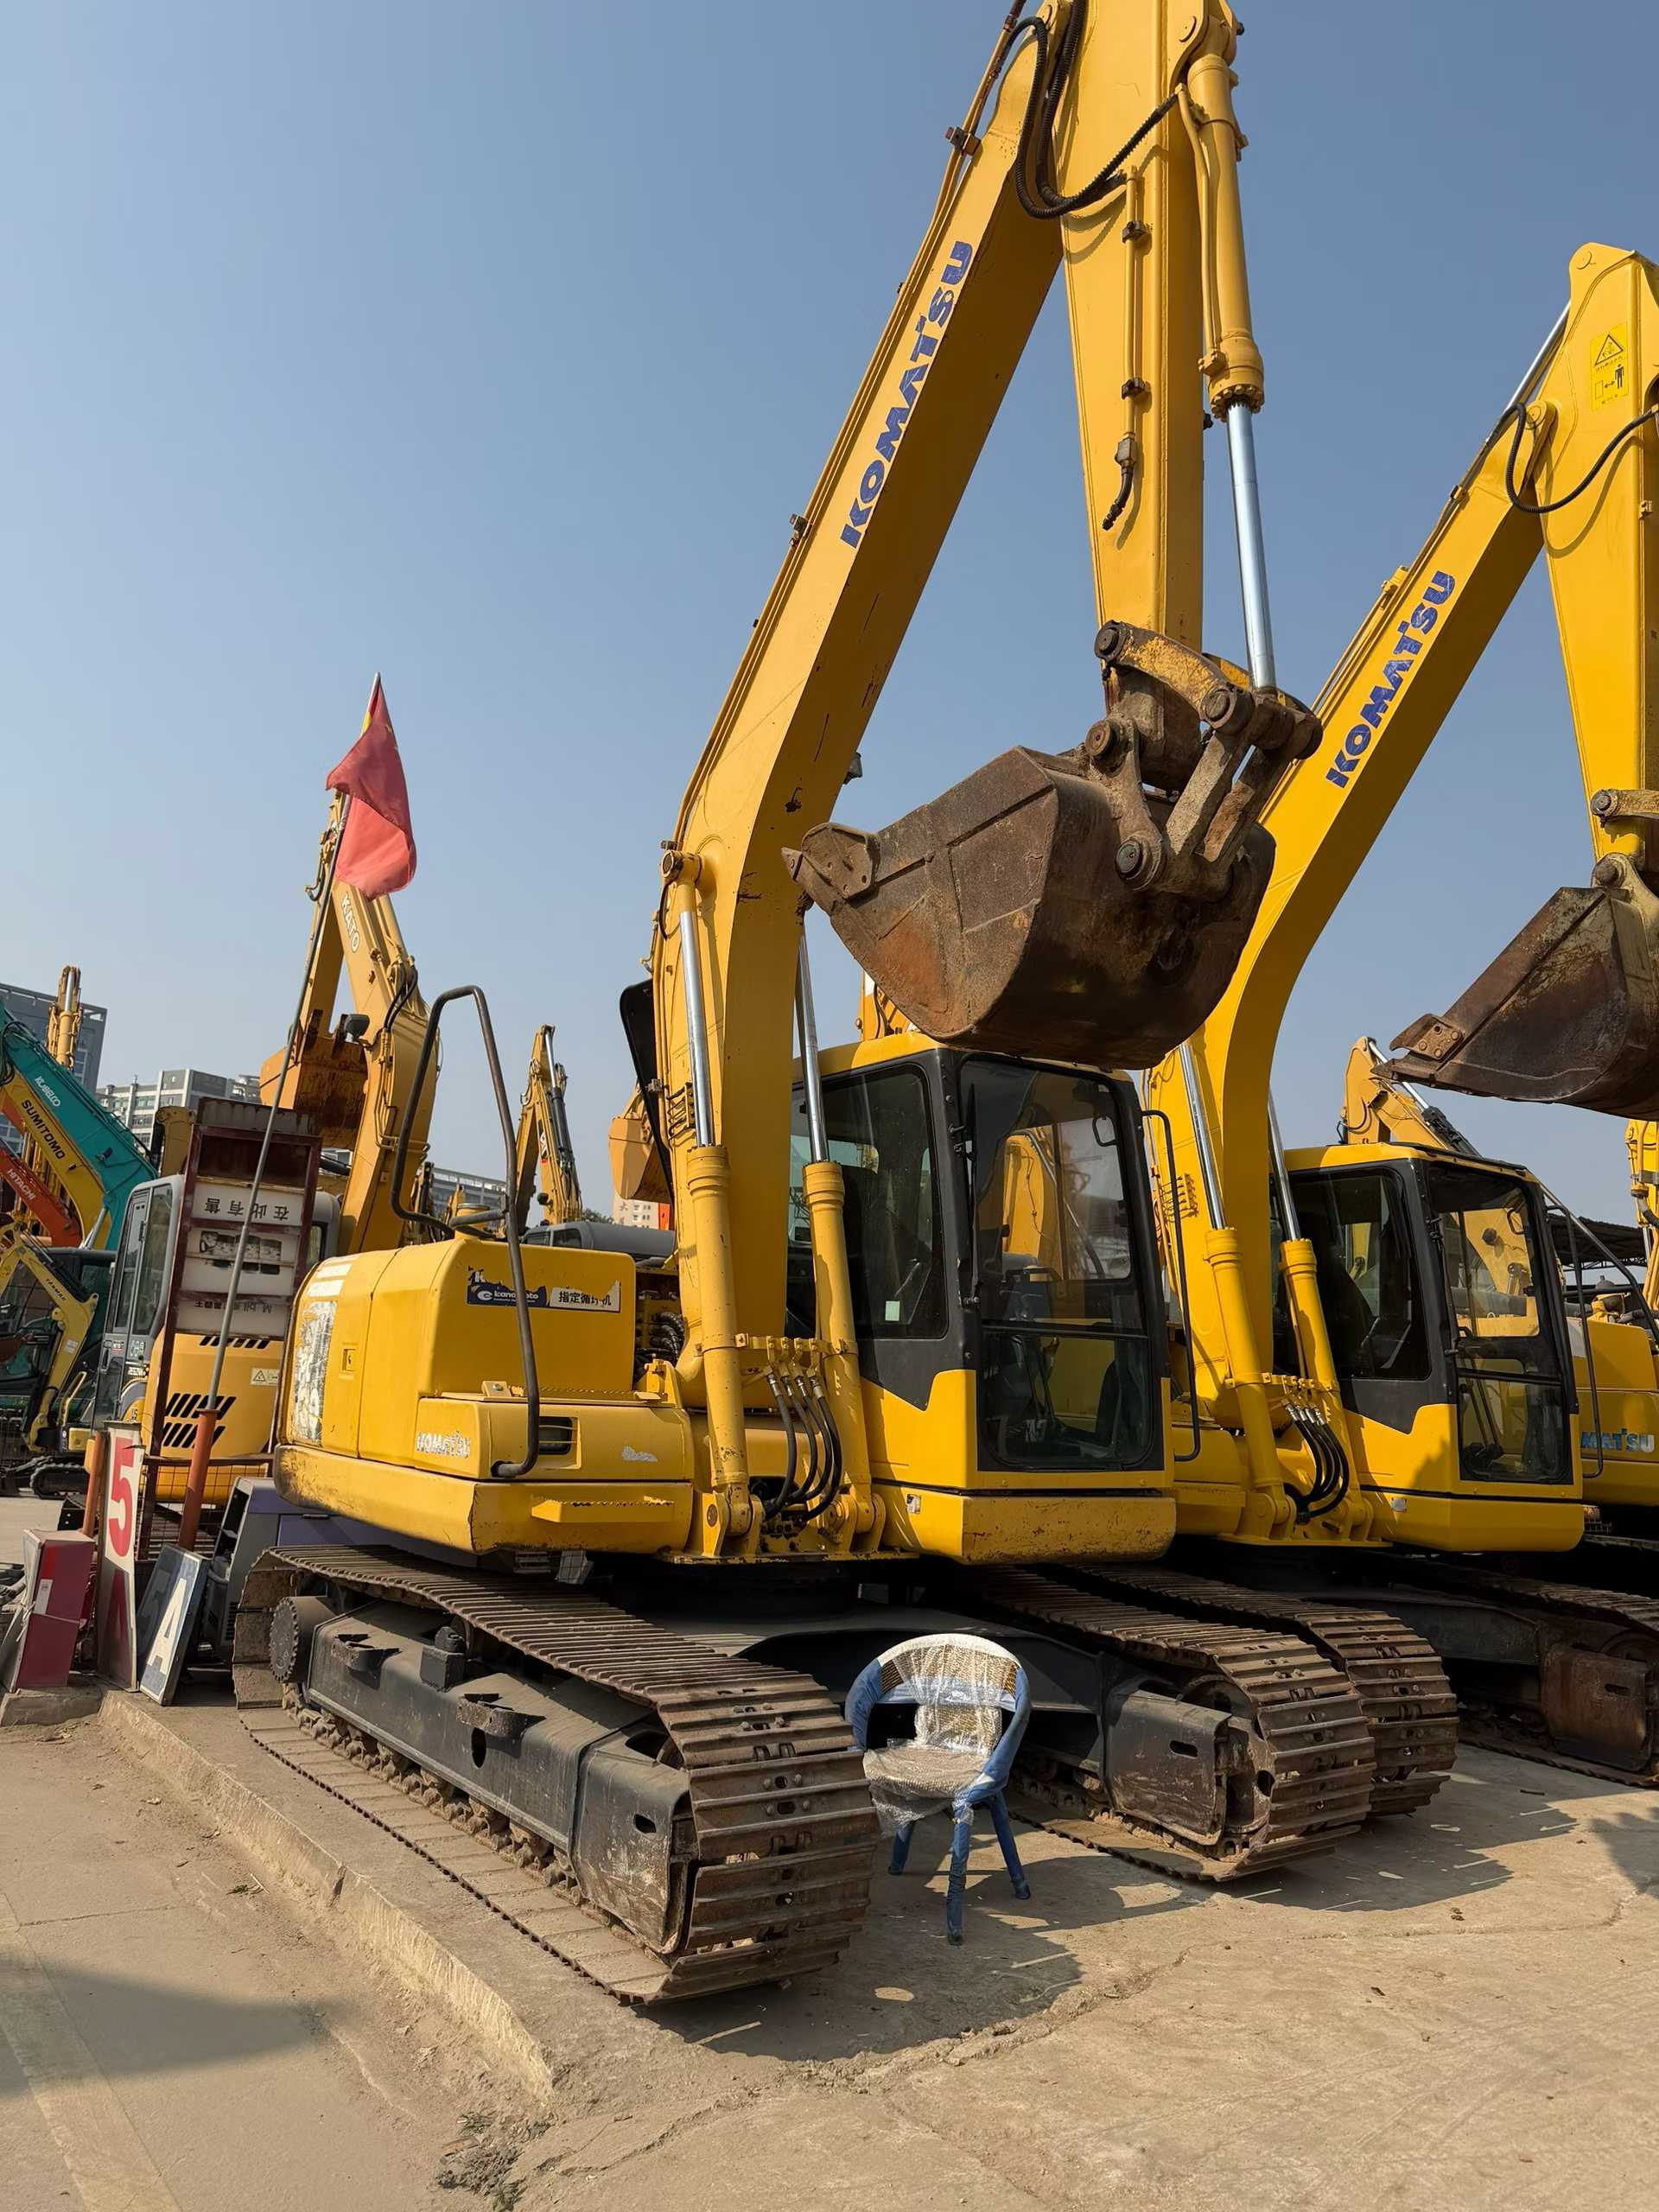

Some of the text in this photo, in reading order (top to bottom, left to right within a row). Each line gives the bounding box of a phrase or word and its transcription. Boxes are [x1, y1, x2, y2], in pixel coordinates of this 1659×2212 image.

[840, 240, 973, 549] KOMATSU
[1325, 569, 1458, 789] KOMATSU
[341, 892, 360, 953] KATO
[22, 1099, 66, 1160] SUMITOMO
[7, 1168, 35, 1200] HITACHI
[204, 1198, 290, 1221] 在此有售
[109, 1436, 137, 1557] 5
[147, 1578, 188, 1675] A
